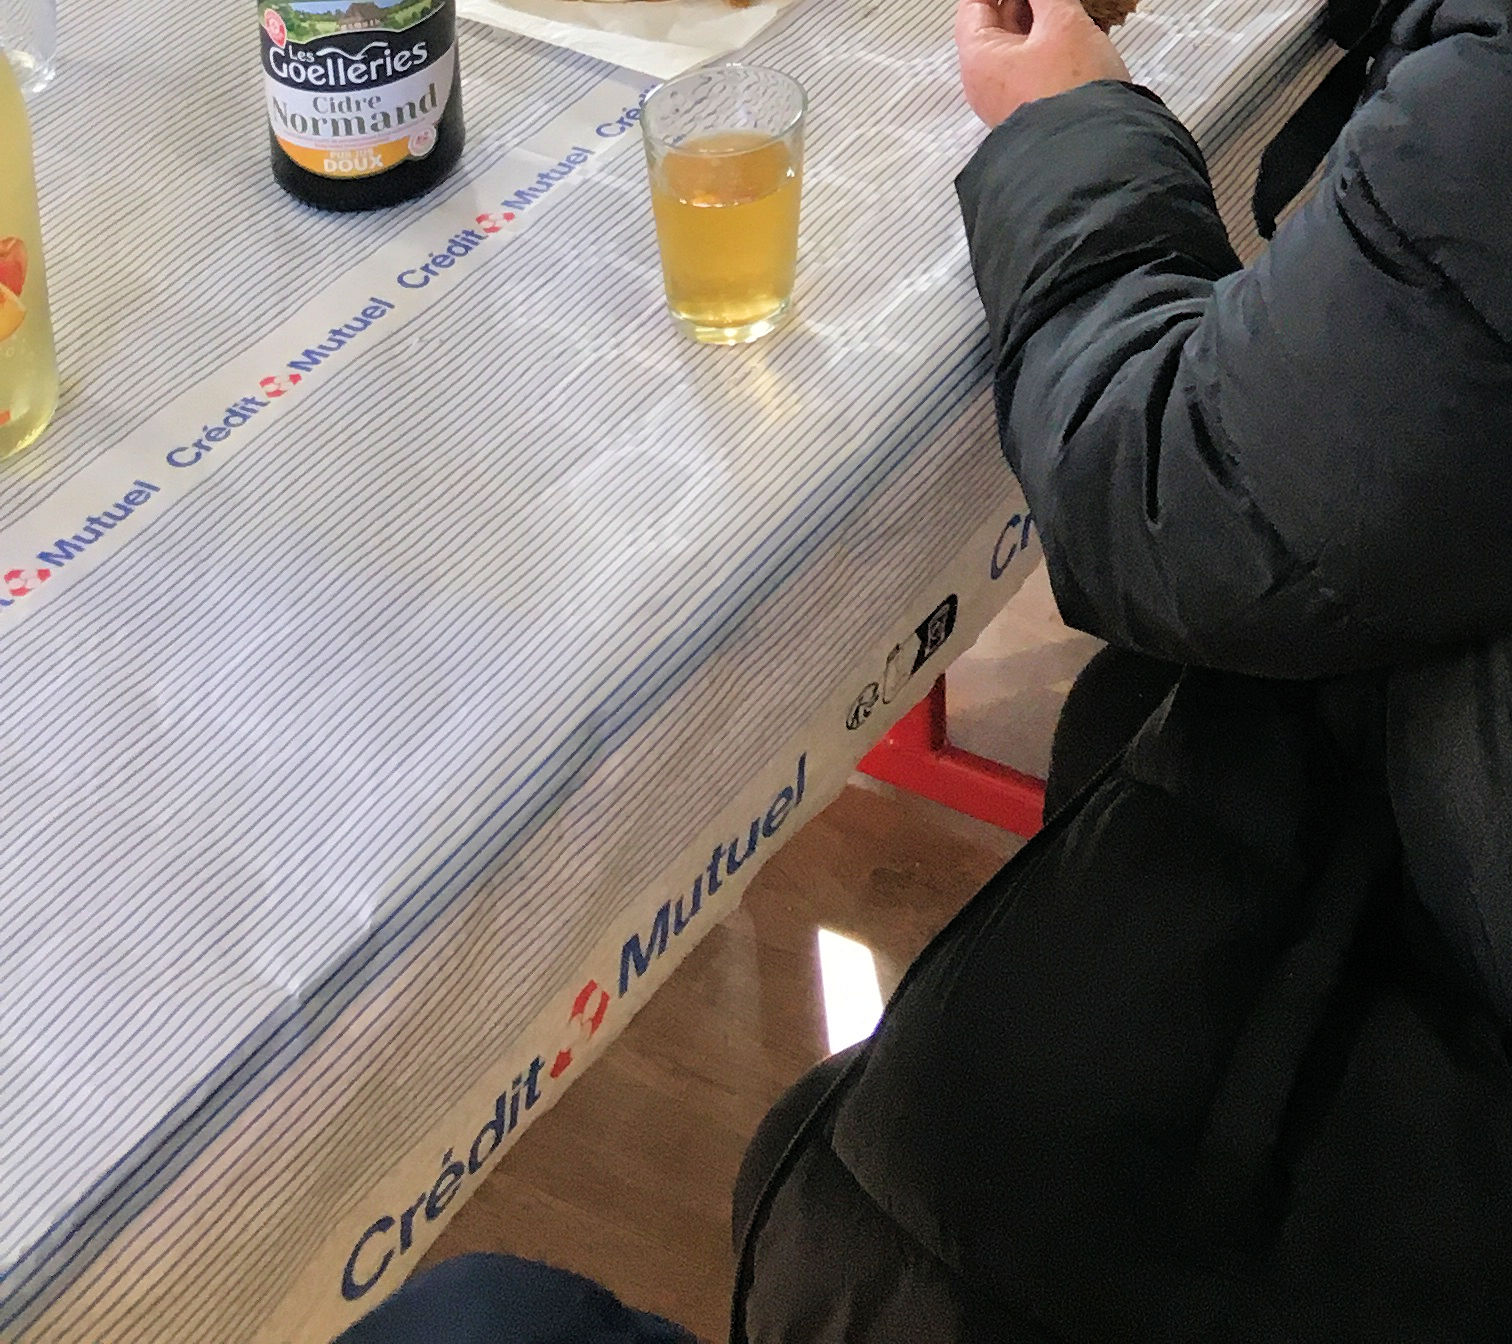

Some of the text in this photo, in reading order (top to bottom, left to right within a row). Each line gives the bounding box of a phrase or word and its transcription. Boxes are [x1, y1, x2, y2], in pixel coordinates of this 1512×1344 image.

[269, 41, 428, 86] Goelleries
[288, 45, 316, 63] Les
[271, 83, 438, 138] Normand
[312, 95, 382, 114] Cidre
[324, 154, 384, 173] DOUX
[36, 479, 161, 568] Mutuel
[166, 396, 271, 469] Crédit
[287, 296, 395, 373] Mutuel
[396, 229, 488, 290] Crédit
[501, 146, 596, 210] Mutuel
[340, 753, 808, 1303] Crédit Mutuel
